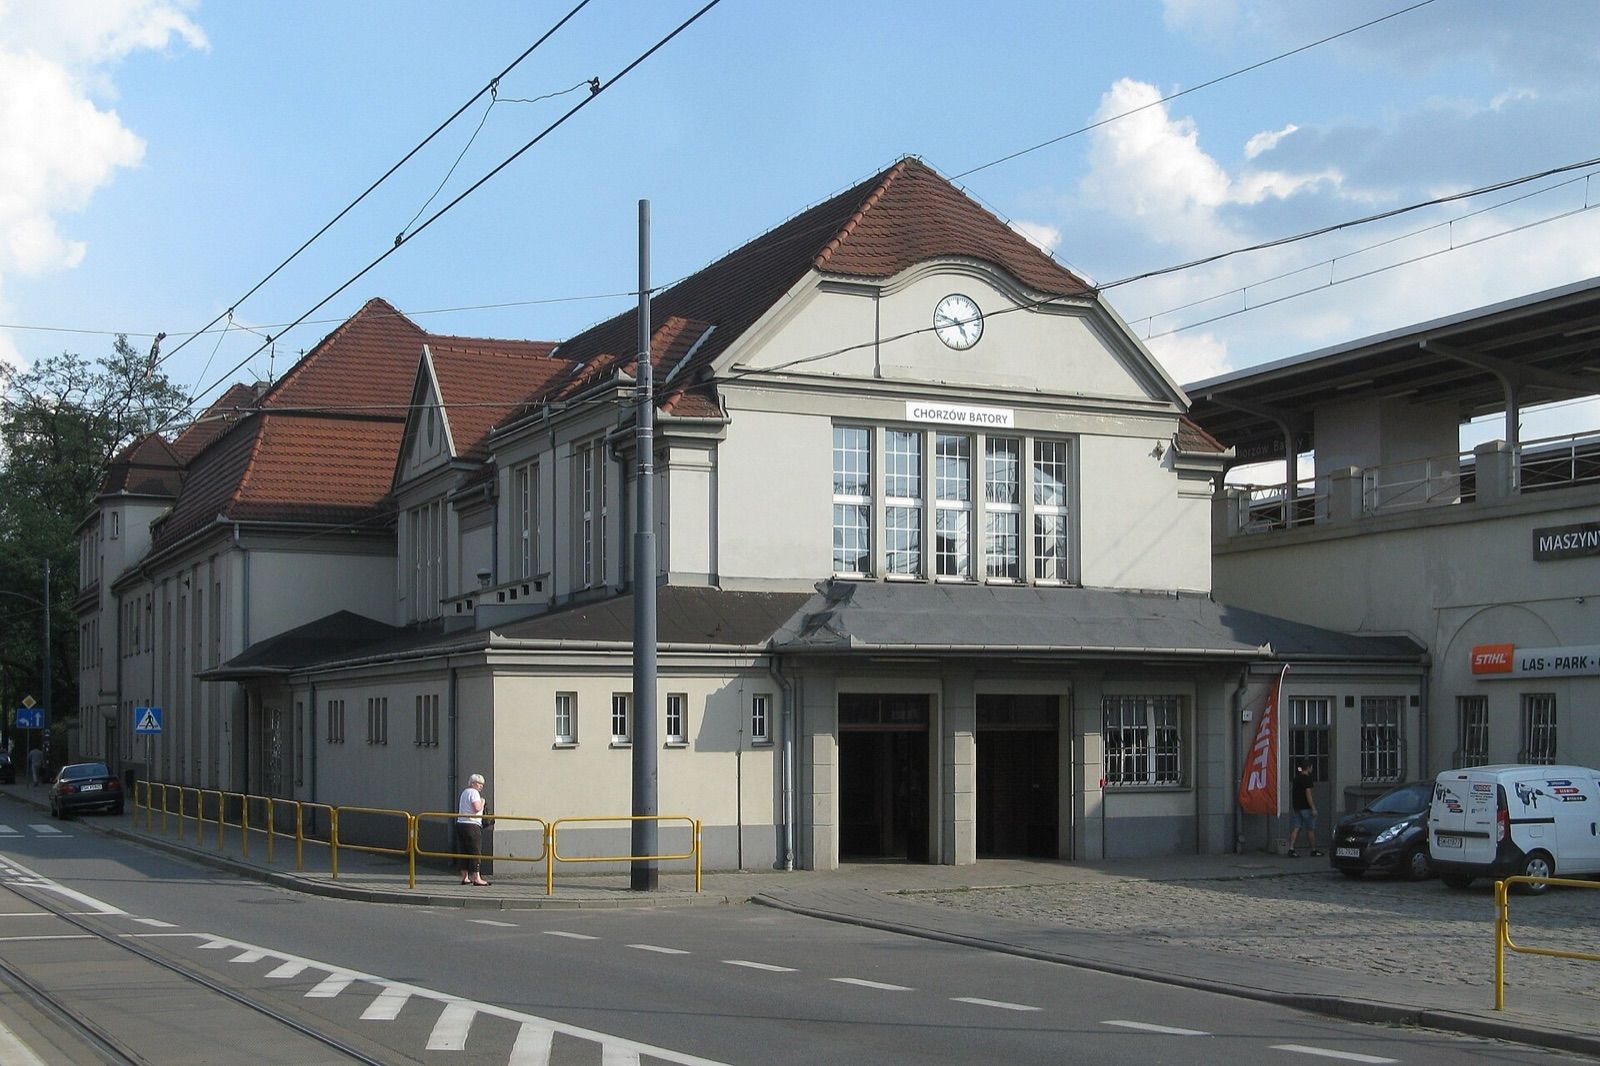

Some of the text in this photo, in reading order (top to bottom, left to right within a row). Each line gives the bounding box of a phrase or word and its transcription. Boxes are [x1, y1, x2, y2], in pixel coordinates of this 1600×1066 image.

[914, 409, 1008, 424] CHORZÓW BATORY
[1540, 531, 1600, 552] MASZYN
[1475, 653, 1506, 665] STIHL
[1522, 658, 1545, 671] LAS
[1555, 656, 1587, 669] PARK
